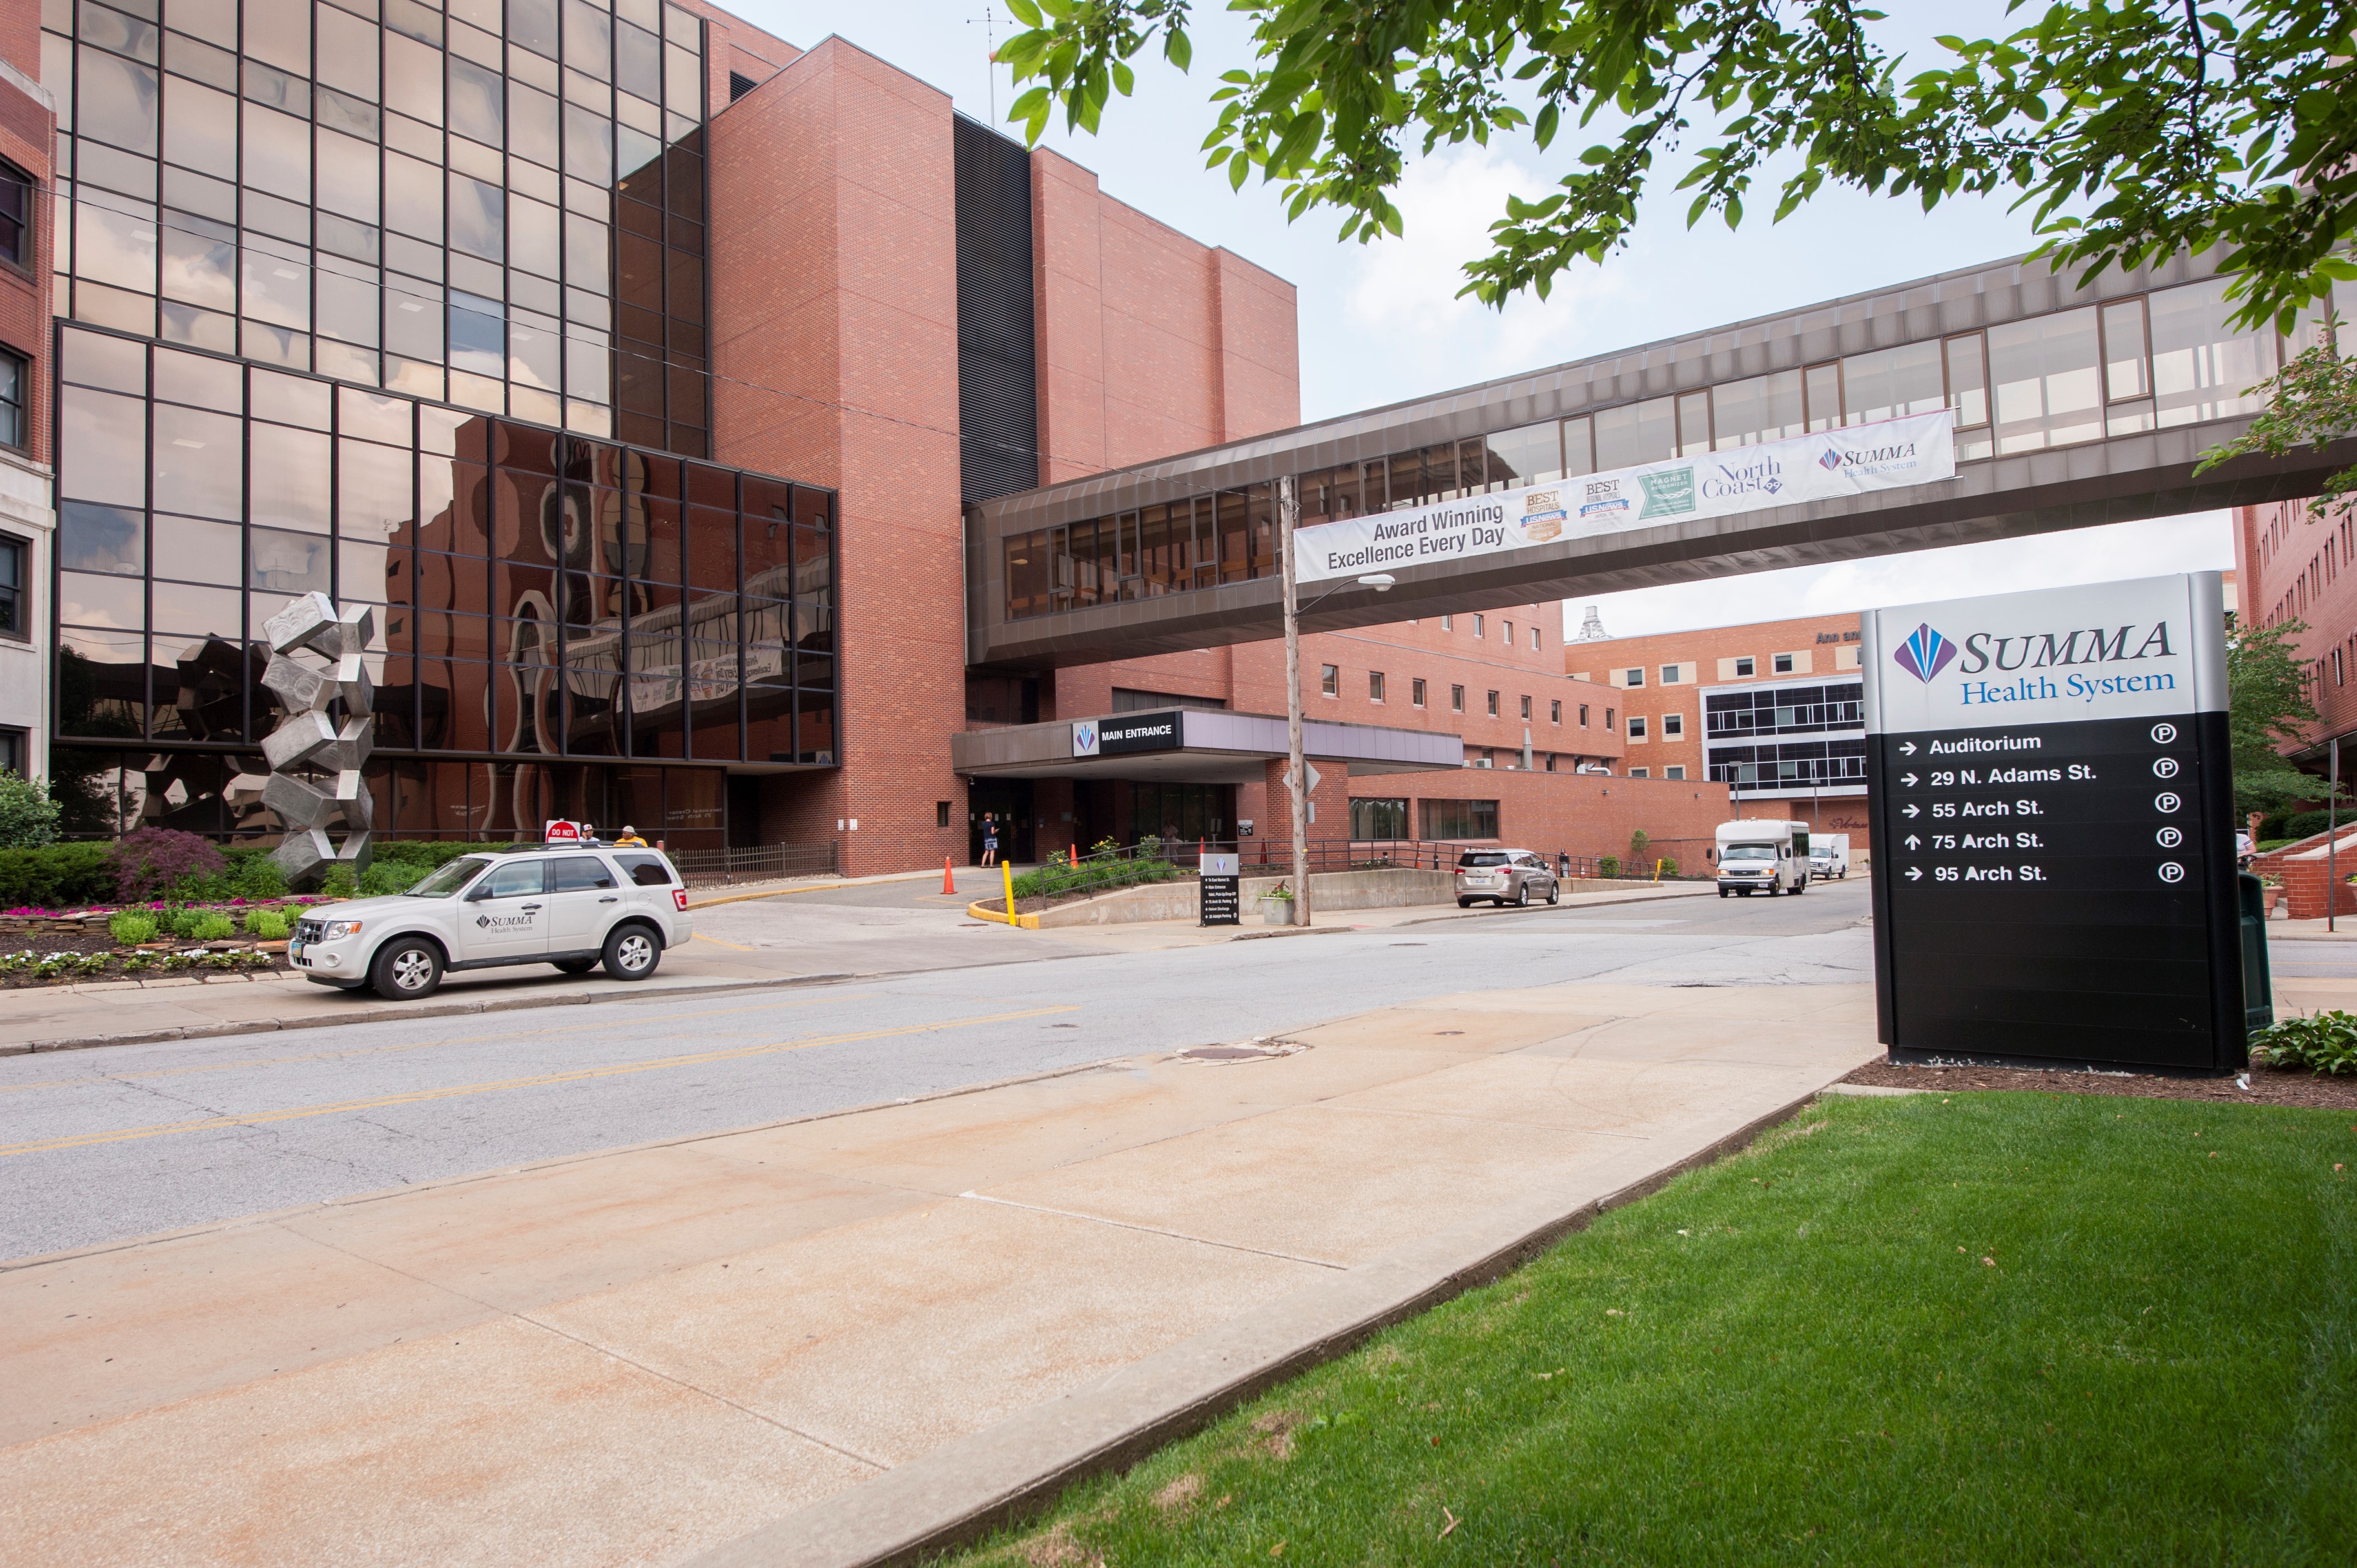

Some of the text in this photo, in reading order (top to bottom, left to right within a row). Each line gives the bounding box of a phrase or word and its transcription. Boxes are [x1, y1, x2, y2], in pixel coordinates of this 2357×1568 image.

[1842, 443, 1917, 466] SUMMA
[1716, 455, 1782, 484] North
[1844, 460, 1917, 479] Health System
[1586, 479, 1620, 496] BEST
[1650, 473, 1687, 486] MAGNET
[1651, 481, 1688, 491] RECOGNIZED
[1702, 477, 1764, 499] Coast
[1766, 481, 1781, 492] 99
[1526, 491, 1559, 507] BEST
[1527, 502, 1560, 515] HOSPITALS
[1374, 504, 1503, 541] Award Winning
[1328, 526, 1505, 570] Excellence Every Day
[1816, 632, 1839, 644] Ann
[1959, 621, 2177, 674] SUMMA
[1960, 673, 2176, 705] Health System
[1102, 725, 1172, 741] MAIN ENTRANCE
[1929, 735, 2041, 755] Auditorium
[1931, 765, 2097, 786] 29 N. Adams St.
[1932, 800, 2044, 818] 55 Arch St.
[1932, 832, 2044, 849] 75 Arch St.
[1935, 865, 2047, 881] 95 Arch St.
[491, 916, 532, 927] SUMMA
